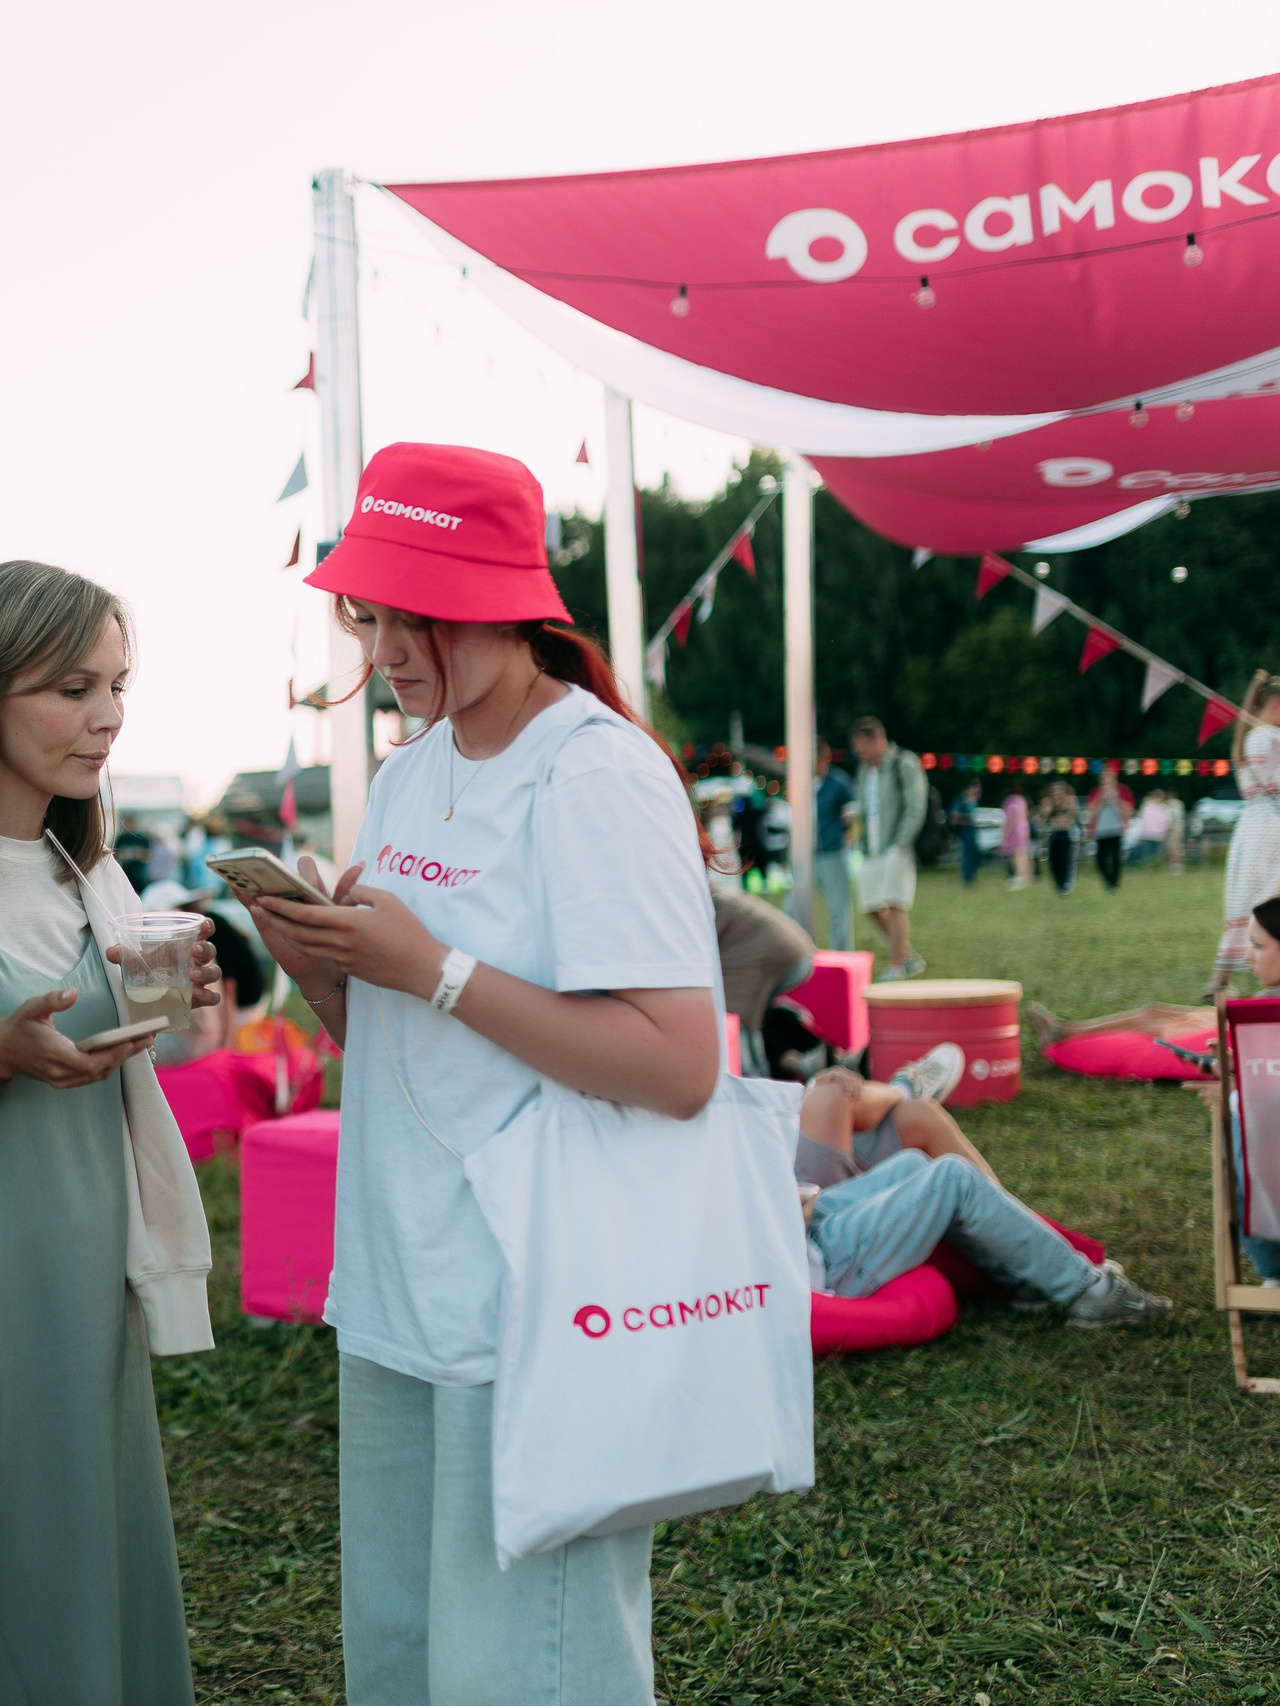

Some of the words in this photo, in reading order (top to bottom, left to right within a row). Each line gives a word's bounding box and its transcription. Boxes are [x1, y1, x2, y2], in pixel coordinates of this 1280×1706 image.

[893, 152, 1280, 264] самок
[372, 499, 463, 531] самокат
[622, 1283, 772, 1333] самокат
